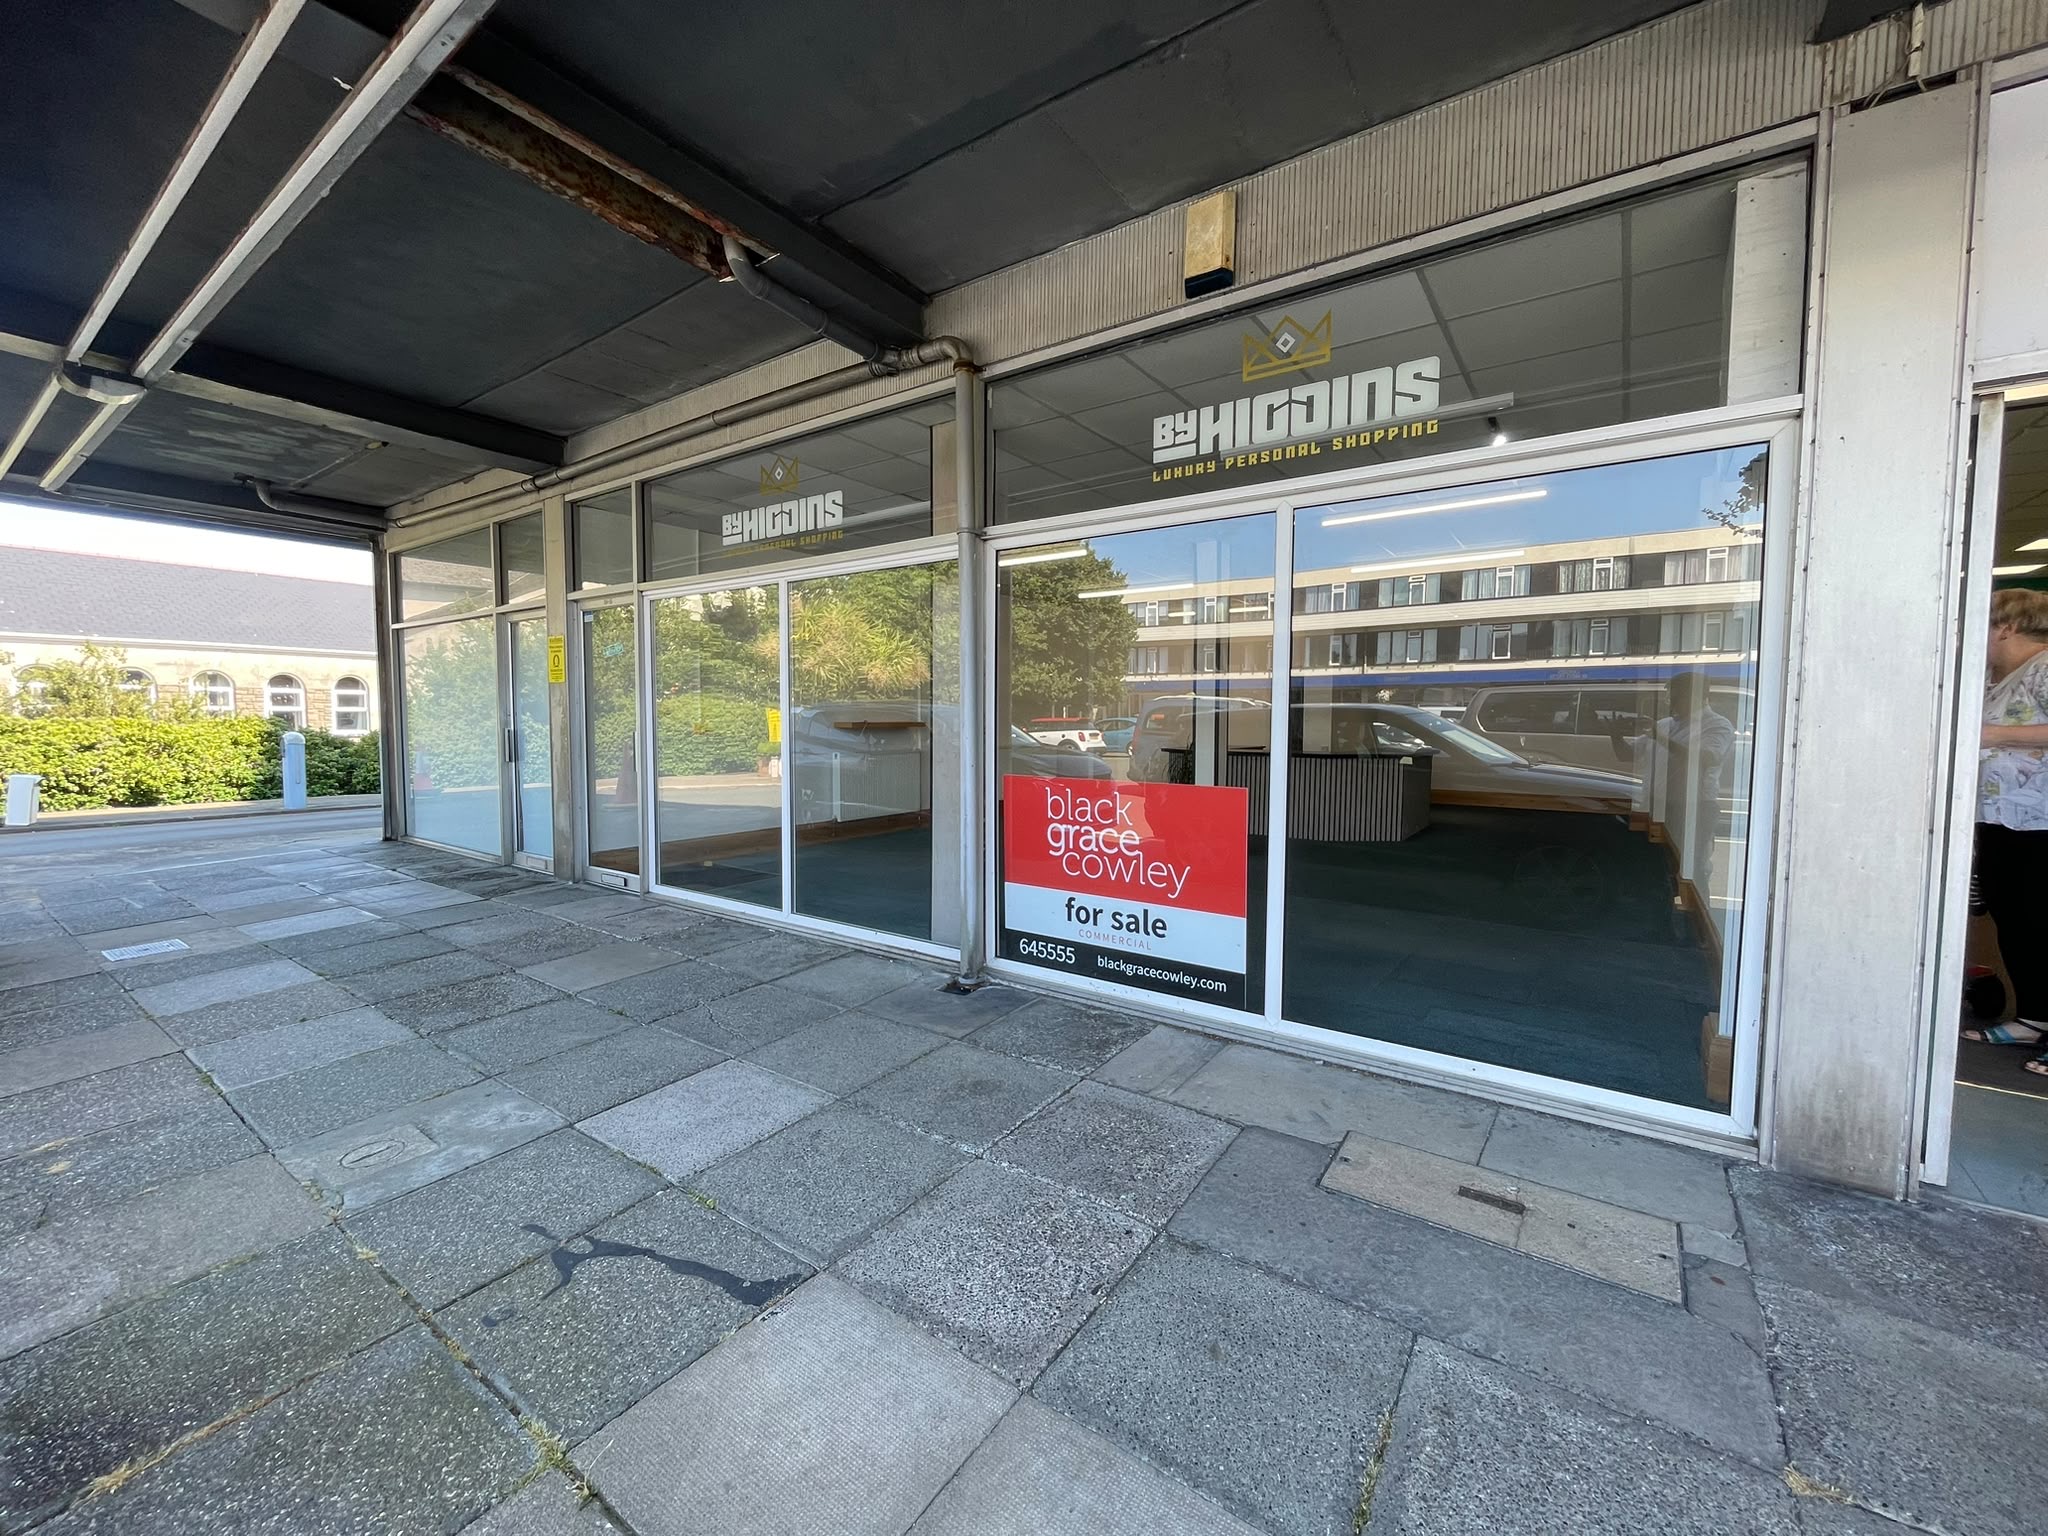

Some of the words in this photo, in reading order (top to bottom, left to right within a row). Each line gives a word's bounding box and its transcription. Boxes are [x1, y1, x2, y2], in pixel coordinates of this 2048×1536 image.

[1152, 460, 1216, 483] LUXURY
[1224, 441, 1321, 470] PERSONAL
[1332, 418, 1439, 450] SHOPPING
[1045, 786, 1134, 826] black
[1047, 822, 1140, 857] grace
[1062, 851, 1191, 899] cowley
[1065, 896, 1104, 927] for
[1111, 908, 1168, 939] sale
[1078, 928, 1152, 951] COMMERCIAL
[1019, 937, 1076, 965] 645555
[1097, 954, 1228, 993] blackgracecowley.com
